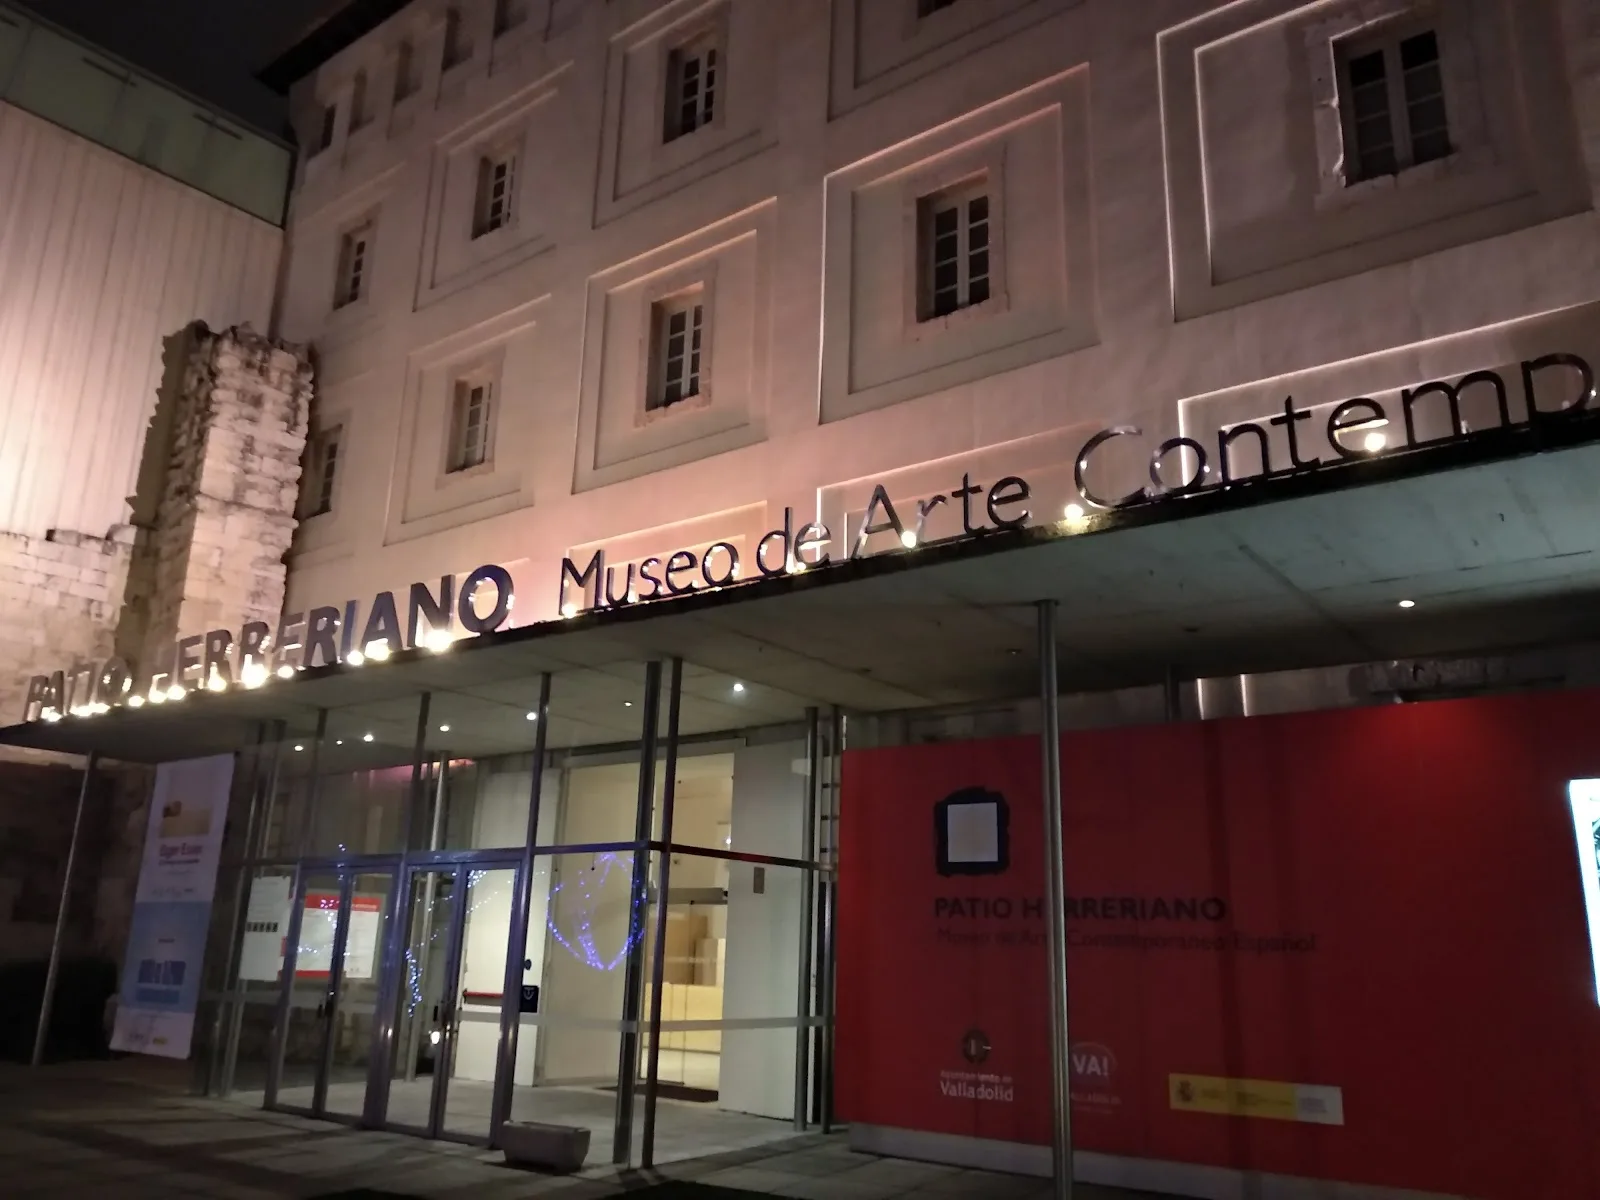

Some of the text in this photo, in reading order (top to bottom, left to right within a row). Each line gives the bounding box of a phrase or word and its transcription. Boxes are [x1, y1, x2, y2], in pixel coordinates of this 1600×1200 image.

[559, 547, 740, 615] Museo
[756, 506, 832, 574] de
[852, 472, 1032, 561] Arte
[933, 895, 1227, 922] PATIO HRRERIANO
[1072, 1053, 1110, 1077] VA!
[939, 1079, 1014, 1103] Valladolid
